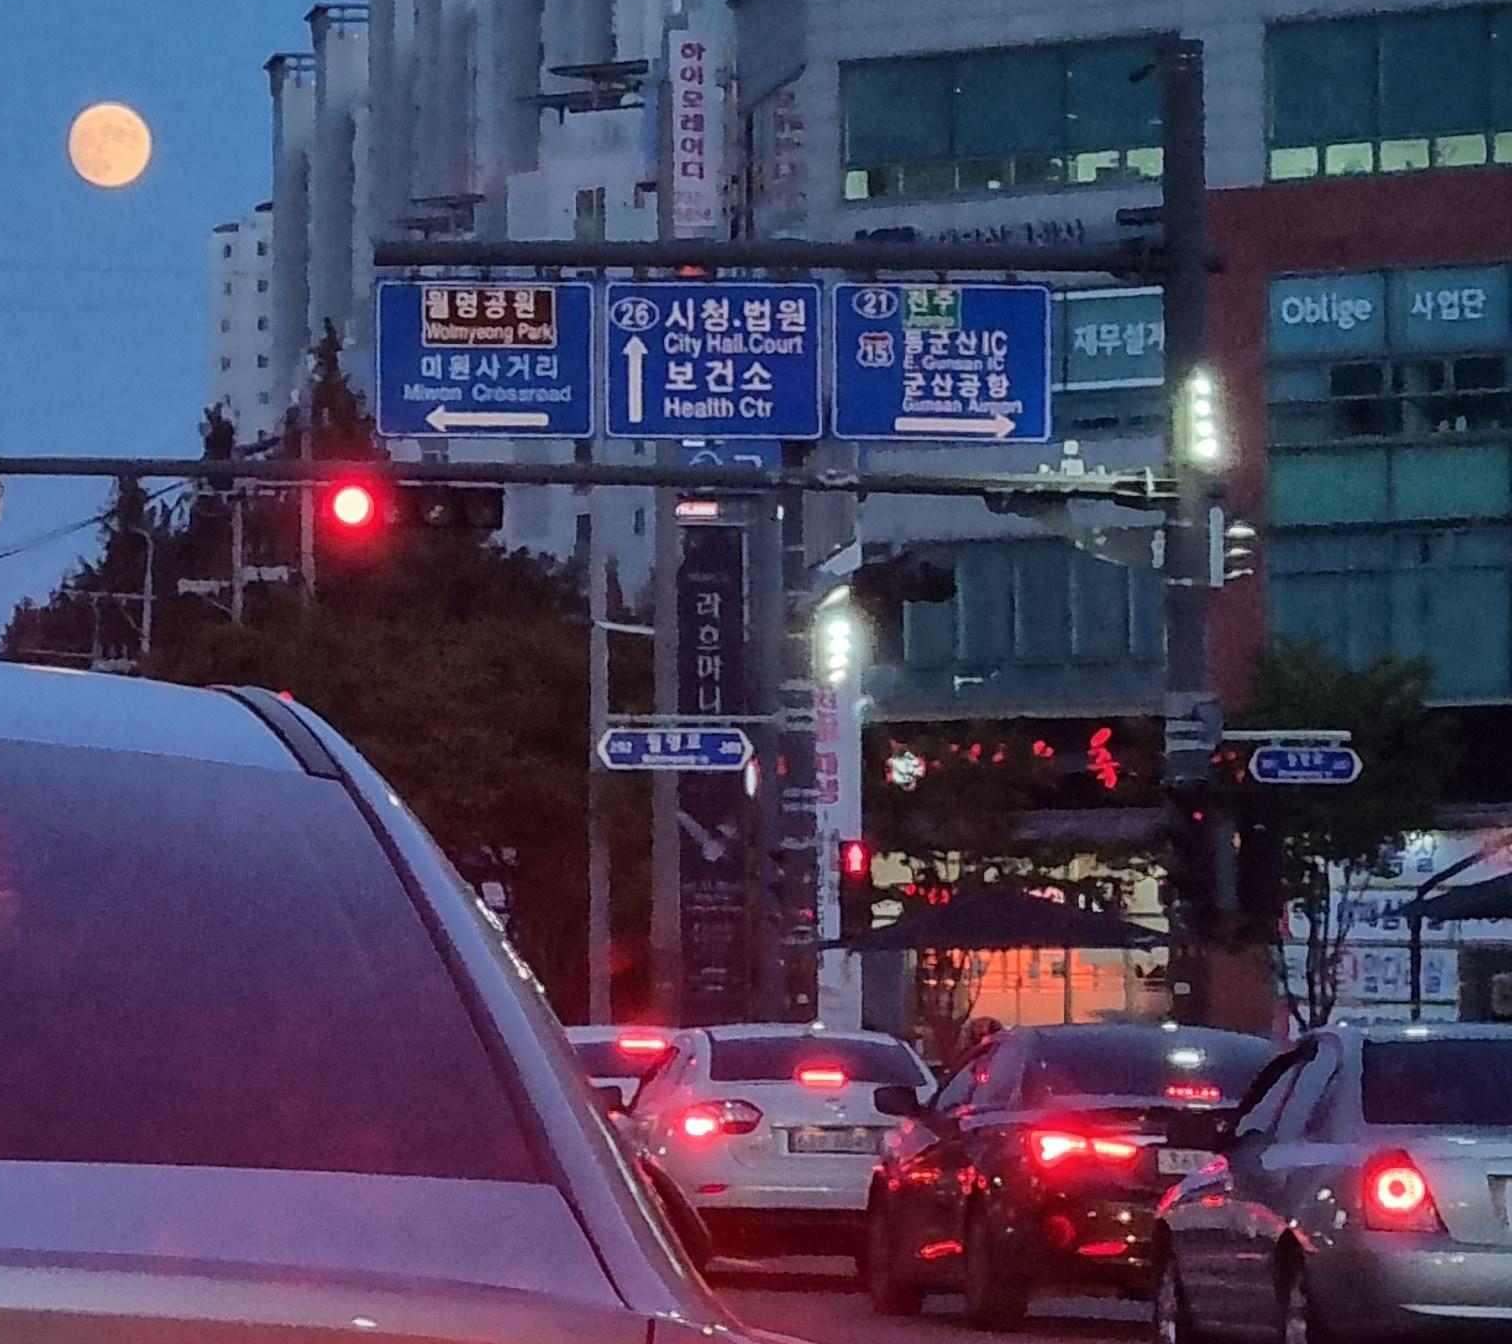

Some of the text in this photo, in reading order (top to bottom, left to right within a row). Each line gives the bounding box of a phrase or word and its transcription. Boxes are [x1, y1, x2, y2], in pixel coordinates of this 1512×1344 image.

[426, 290, 535, 319] 월명공원
[620, 303, 650, 326] 26
[863, 292, 888, 314] 21
[907, 289, 954, 315] 전주
[1281, 292, 1372, 330] Oblige
[1411, 288, 1488, 321] 사업단
[426, 323, 553, 344] Wolmyeong Park
[663, 332, 702, 358] City
[865, 344, 888, 362] 15
[421, 353, 558, 381] 미원사거리
[664, 359, 773, 393] 보건소
[902, 372, 1010, 398] 군산공항
[663, 397, 774, 418] Health Ctr
